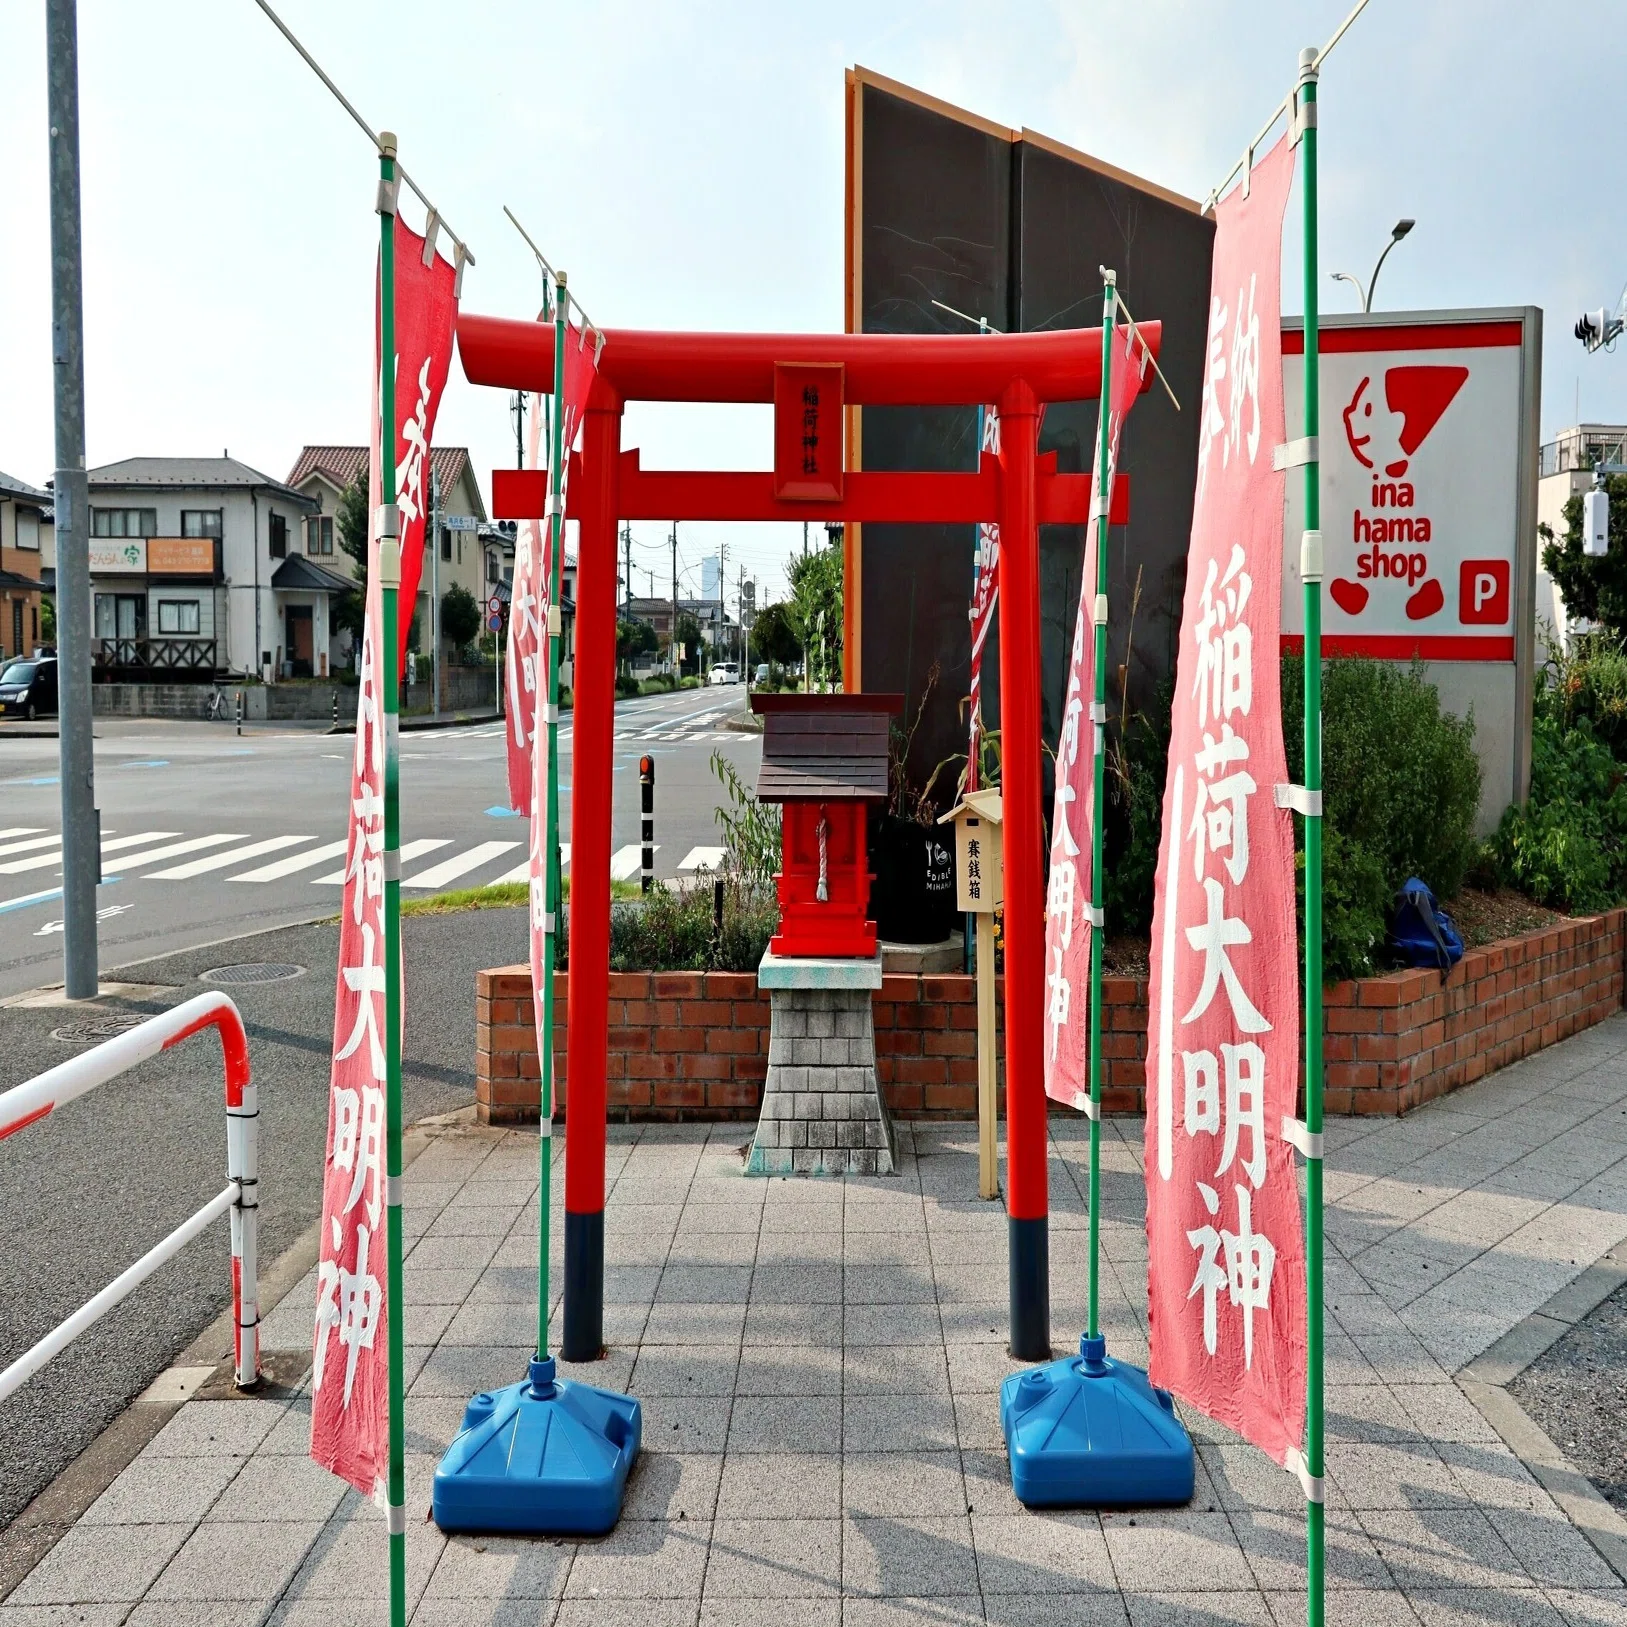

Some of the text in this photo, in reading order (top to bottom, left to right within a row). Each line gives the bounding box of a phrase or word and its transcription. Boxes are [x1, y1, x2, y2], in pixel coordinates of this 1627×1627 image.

[803, 384, 819, 474] 稲荷神社
[1372, 474, 1414, 507] ina
[1354, 509, 1431, 543] hama
[1357, 545, 1427, 587] shop
[1474, 574, 1498, 612] P
[926, 867, 951, 881] EDIBLE
[968, 839, 981, 899] 賽銭箱
[1181, 543, 1276, 1371] 稲荷大明神
